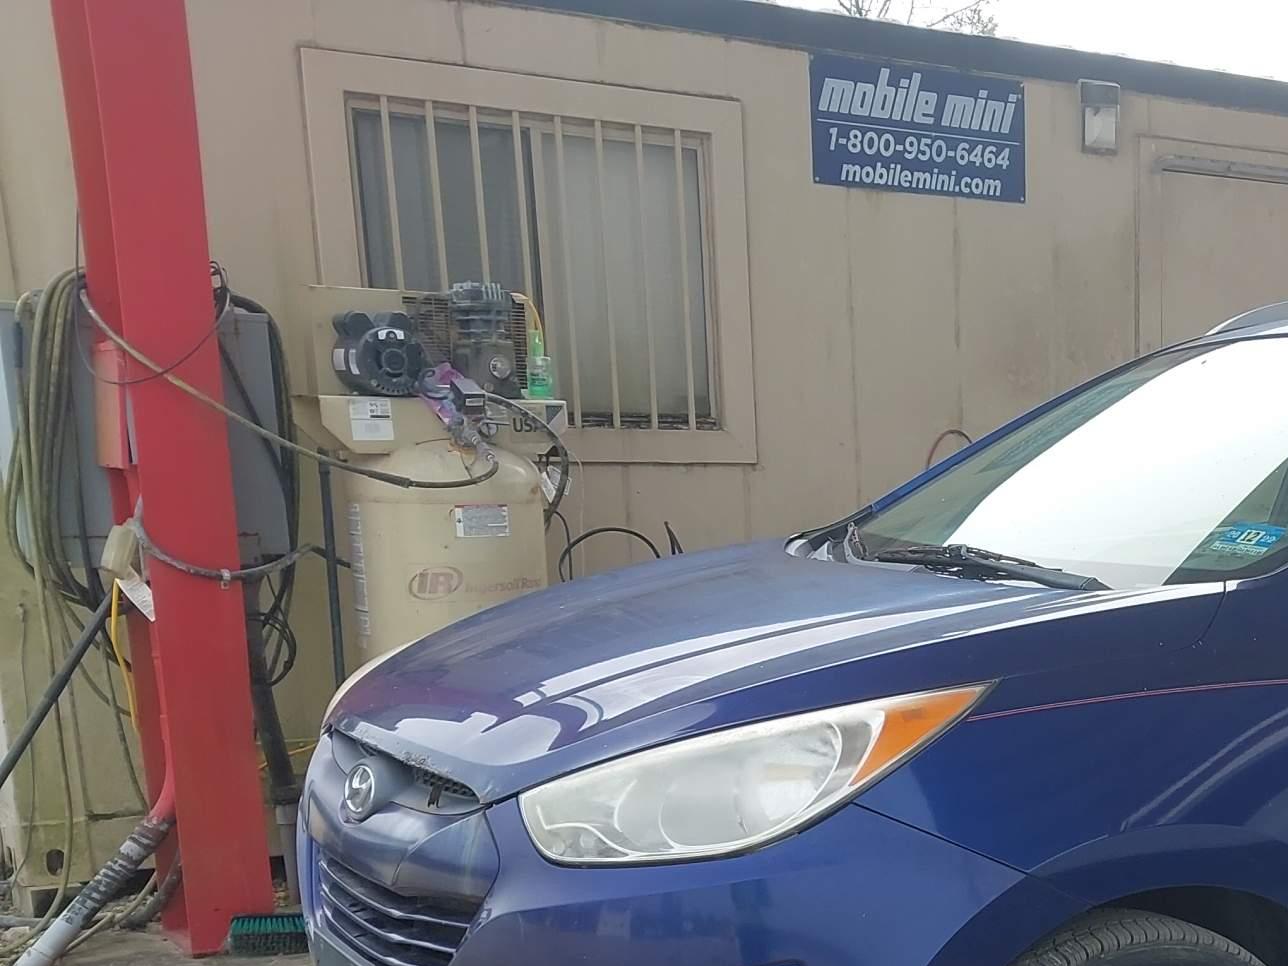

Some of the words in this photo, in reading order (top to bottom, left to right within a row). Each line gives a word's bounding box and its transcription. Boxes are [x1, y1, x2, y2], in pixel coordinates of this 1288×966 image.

[818, 67, 938, 125] mobile
[940, 89, 1017, 134] mini
[828, 127, 1010, 169] 1-800-950-6464
[840, 162, 1002, 196] mobilemini.com
[1240, 531, 1260, 542] 12
